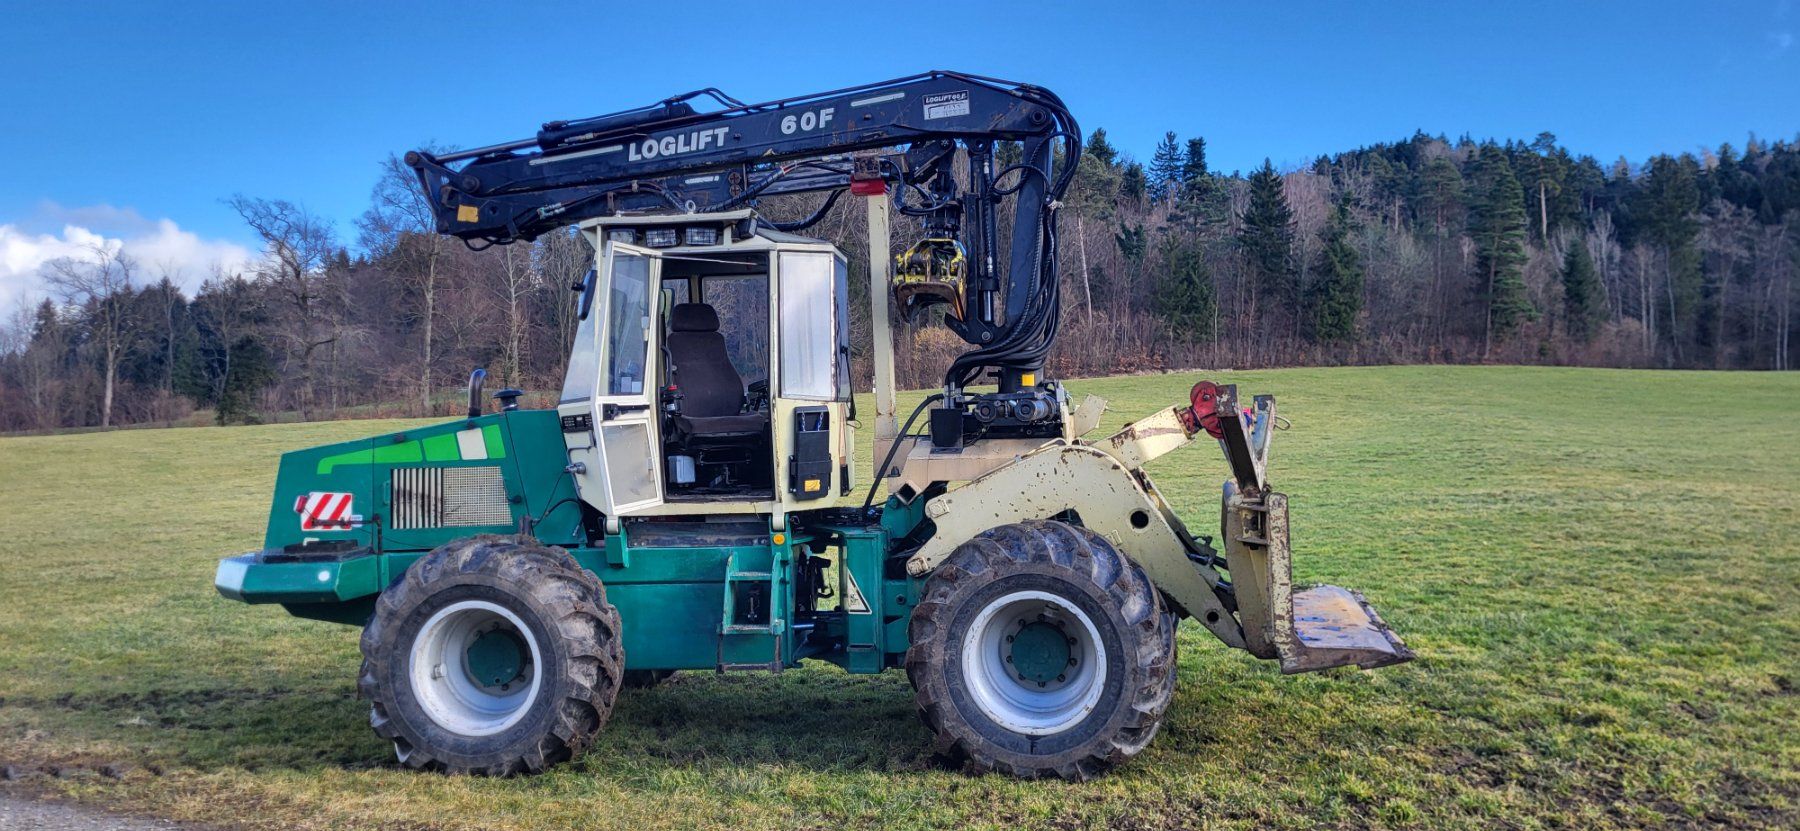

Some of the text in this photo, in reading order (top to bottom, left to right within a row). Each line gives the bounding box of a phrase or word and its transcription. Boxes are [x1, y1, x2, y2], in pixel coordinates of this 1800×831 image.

[926, 95, 951, 103] LOGLIFT
[628, 107, 835, 162] LOGLIFT 60F
